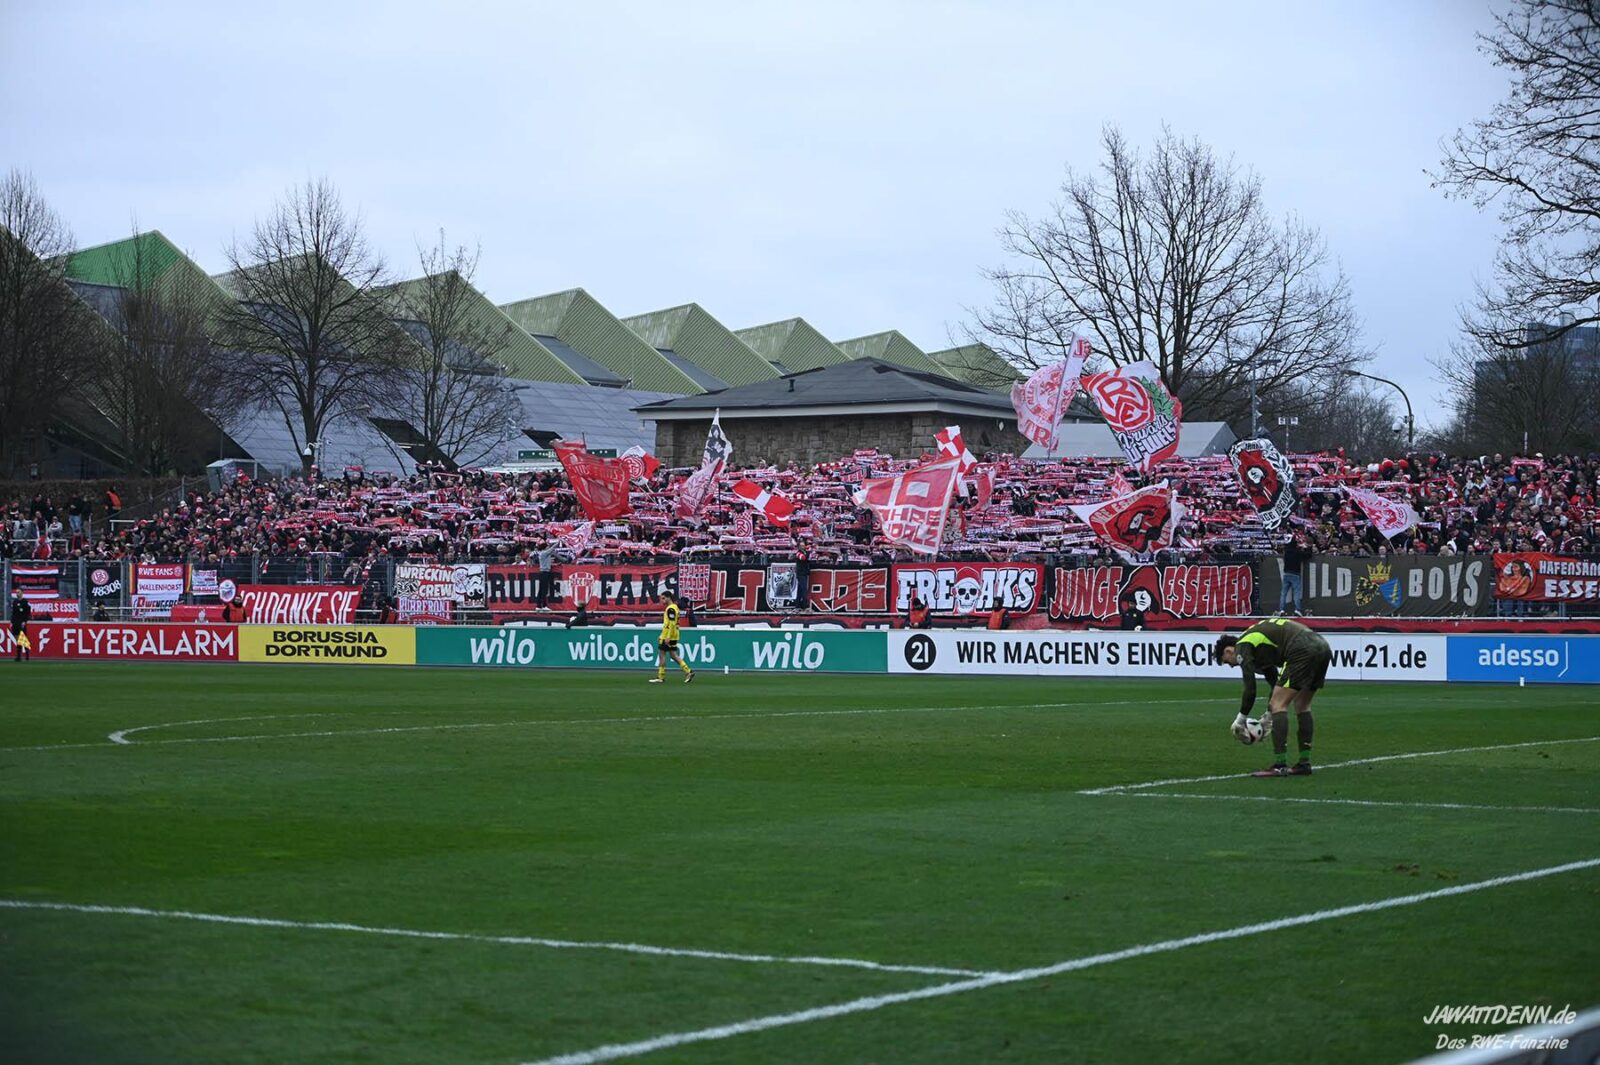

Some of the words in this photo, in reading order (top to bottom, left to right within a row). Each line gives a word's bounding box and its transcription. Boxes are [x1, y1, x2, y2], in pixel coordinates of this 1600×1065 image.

[138, 568, 154, 576] RWE
[155, 567, 174, 576] FANS
[1408, 561, 1483, 607] BOYS
[91, 580, 122, 597] 48308
[139, 583, 182, 591] WALLENHORST
[420, 584, 453, 597] CREW
[599, 572, 680, 605] FANS
[896, 568, 1037, 613] FREAKS
[1050, 566, 1123, 619] JUNGE
[1162, 565, 1253, 617] ESSENER
[1545, 578, 1600, 599] ESSE
[264, 591, 328, 624] DANKE
[326, 591, 359, 624] SIE
[63, 628, 234, 656] FLYERALARM
[273, 630, 379, 644] BORUSSIA
[470, 629, 536, 664] wilo
[265, 644, 388, 658] DORTMUND
[752, 631, 825, 669] wilo
[911, 641, 929, 663] 21
[956, 641, 997, 664] WIR
[1004, 641, 1120, 666] MACHEN'S
[1478, 642, 1560, 667] adesso
